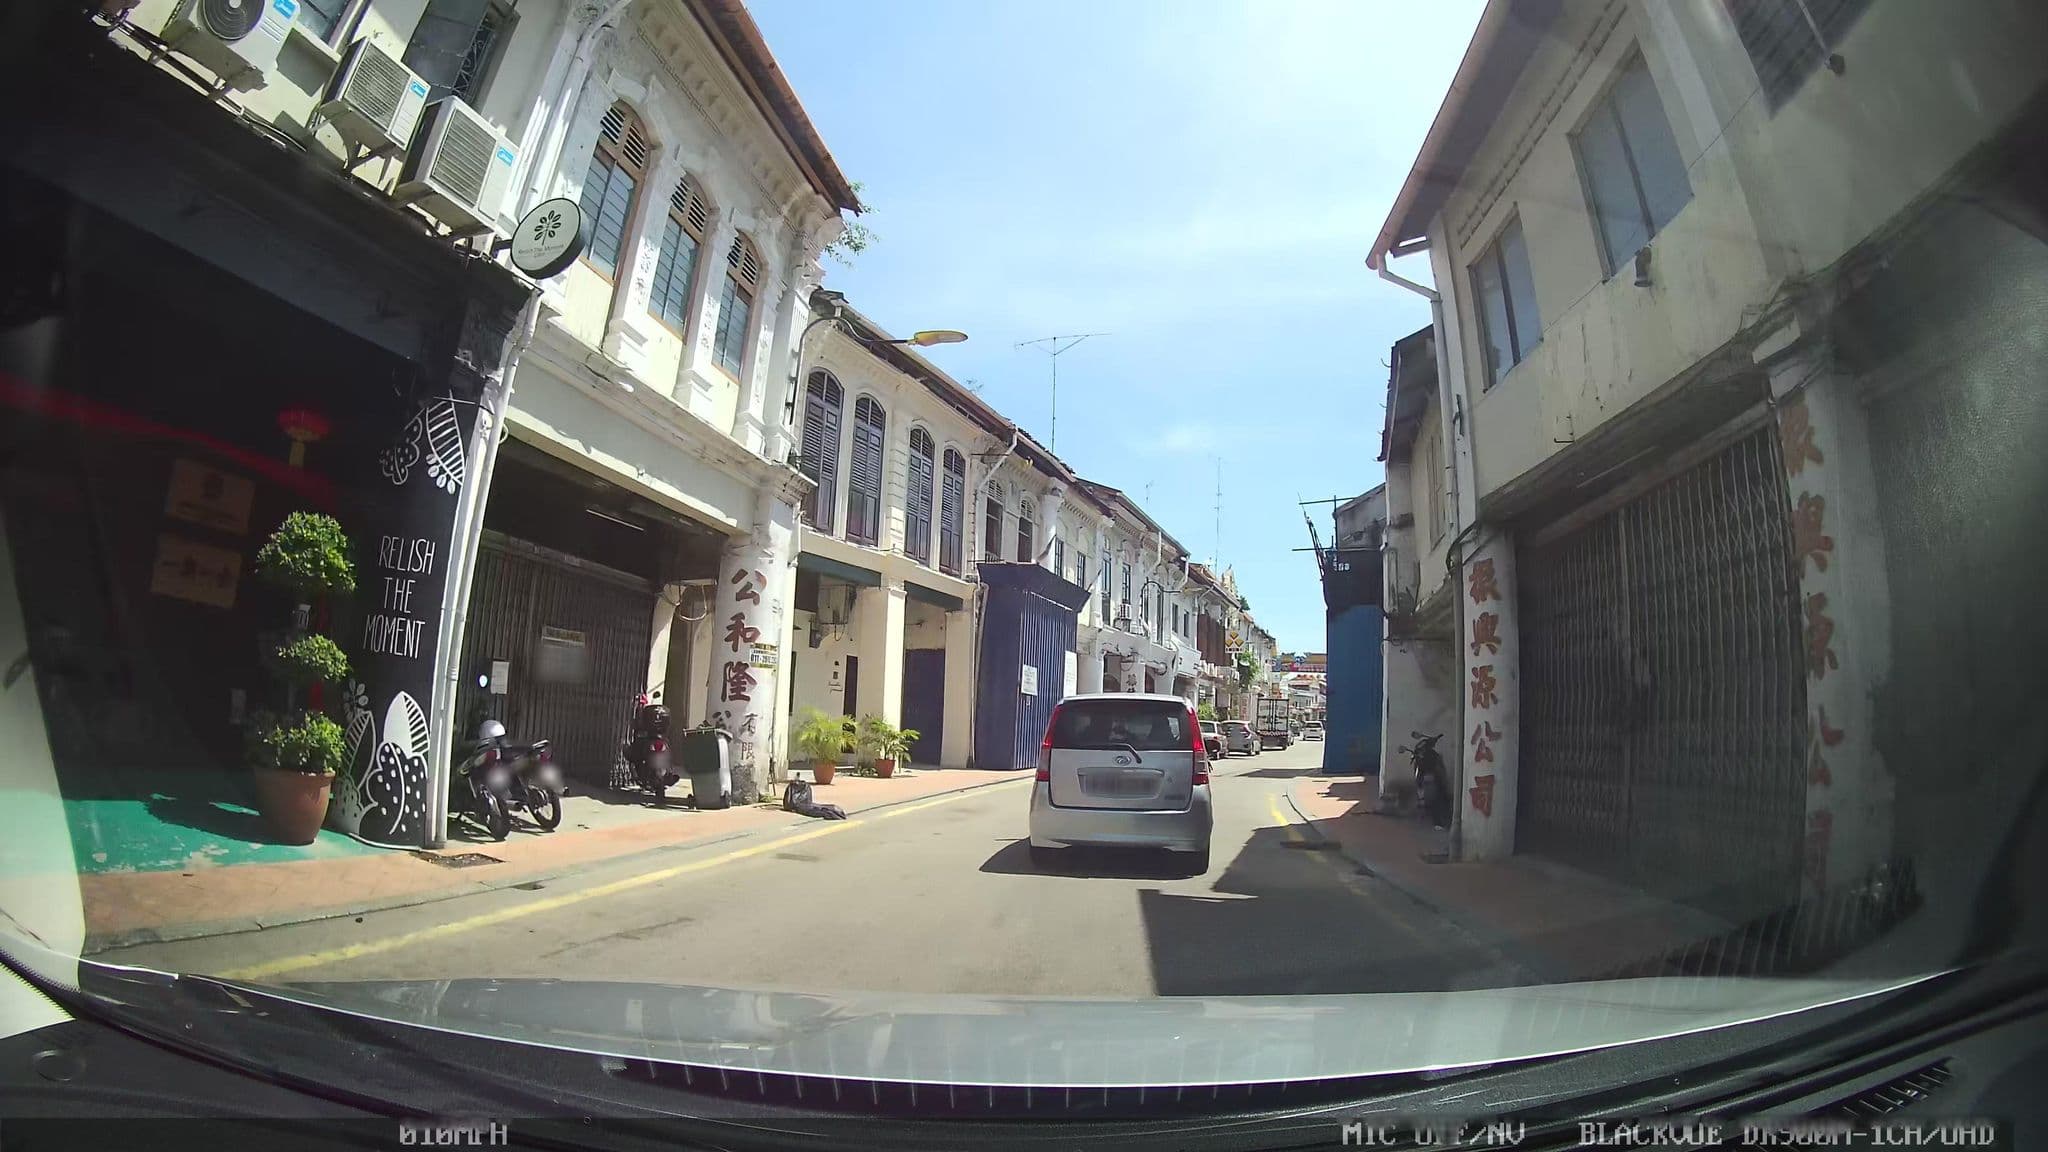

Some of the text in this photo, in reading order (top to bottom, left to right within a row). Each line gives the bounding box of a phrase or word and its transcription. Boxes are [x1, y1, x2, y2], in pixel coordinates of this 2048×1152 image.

[379, 536, 436, 575] RELISH
[384, 577, 416, 613] THE
[363, 614, 426, 659] MOMENT
[721, 568, 768, 702] 公和隆
